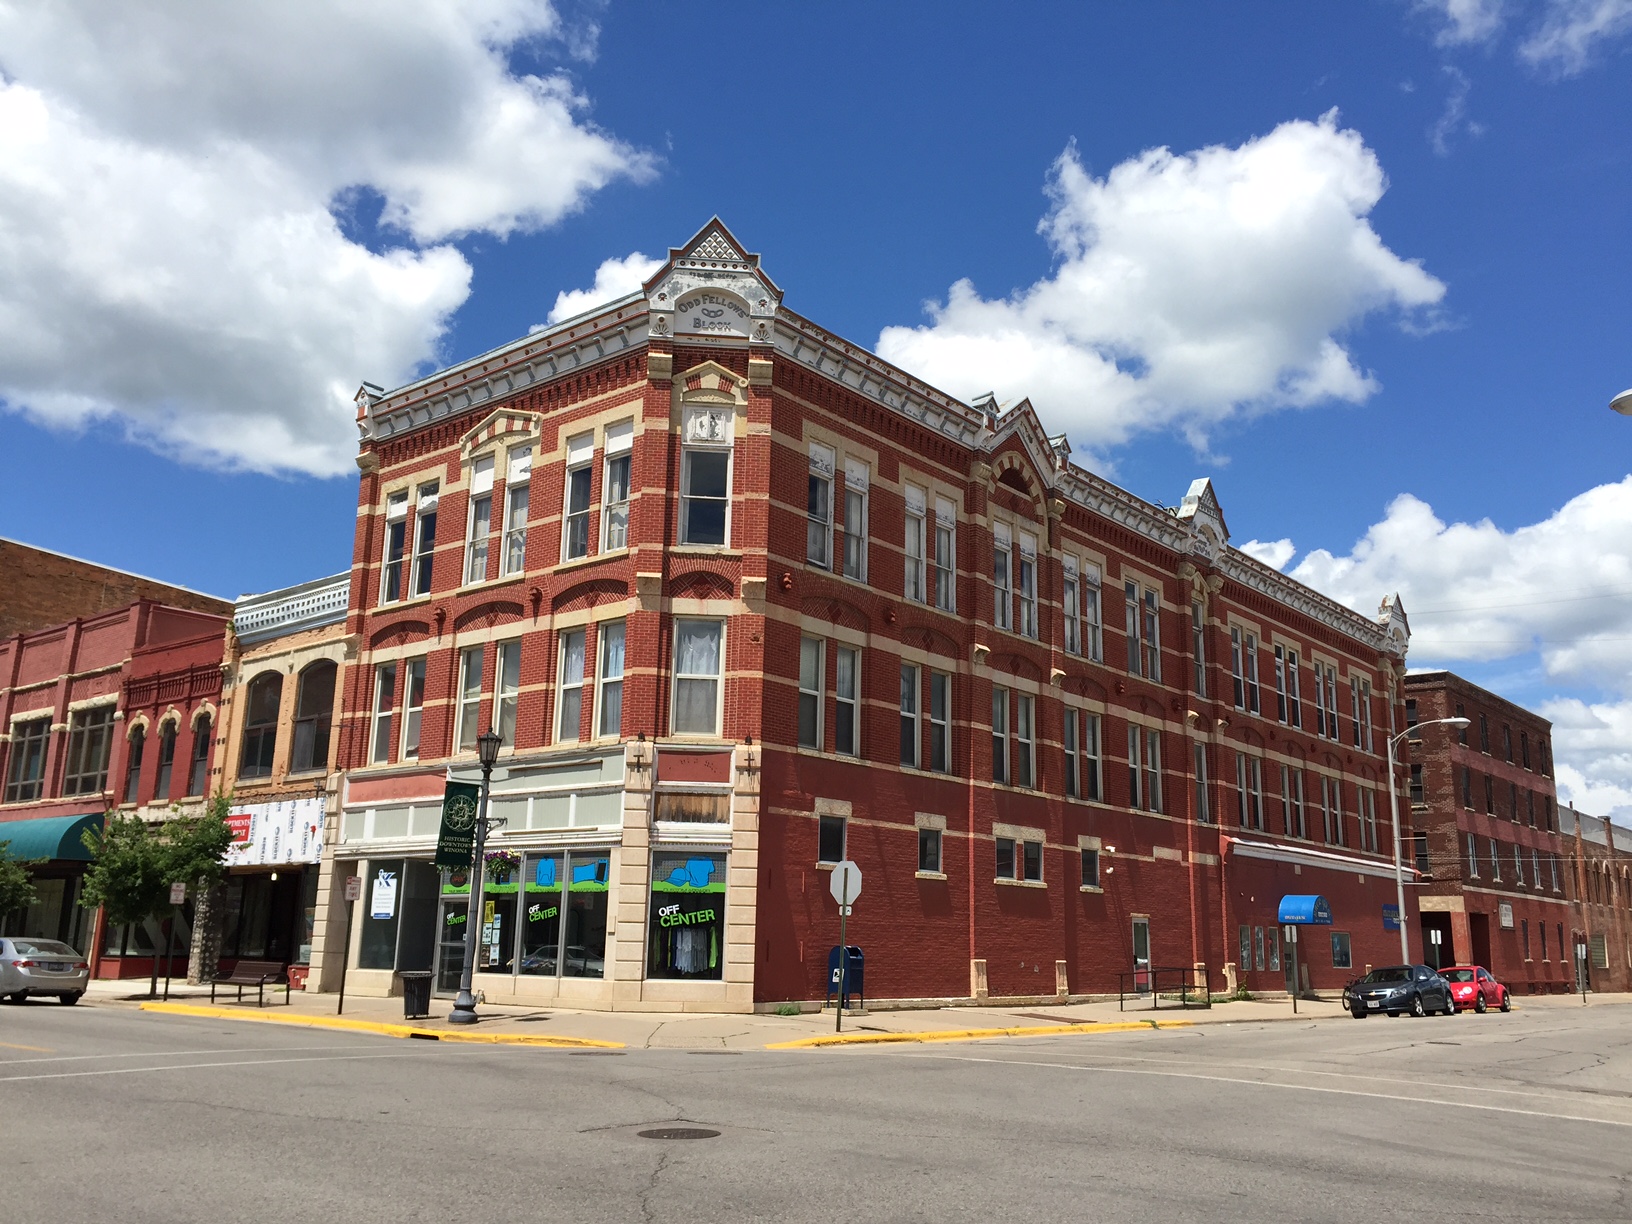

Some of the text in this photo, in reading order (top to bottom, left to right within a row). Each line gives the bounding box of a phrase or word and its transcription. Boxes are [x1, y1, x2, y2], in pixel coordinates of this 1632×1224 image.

[678, 297, 701, 313] ODD
[693, 317, 731, 331] BLOCK
[446, 911, 455, 919] OFF
[529, 904, 540, 914] OFF
[529, 907, 558, 923] CENTER
[658, 904, 680, 917] OFF
[447, 915, 466, 926] CENTER
[660, 909, 716, 928] CENTER
